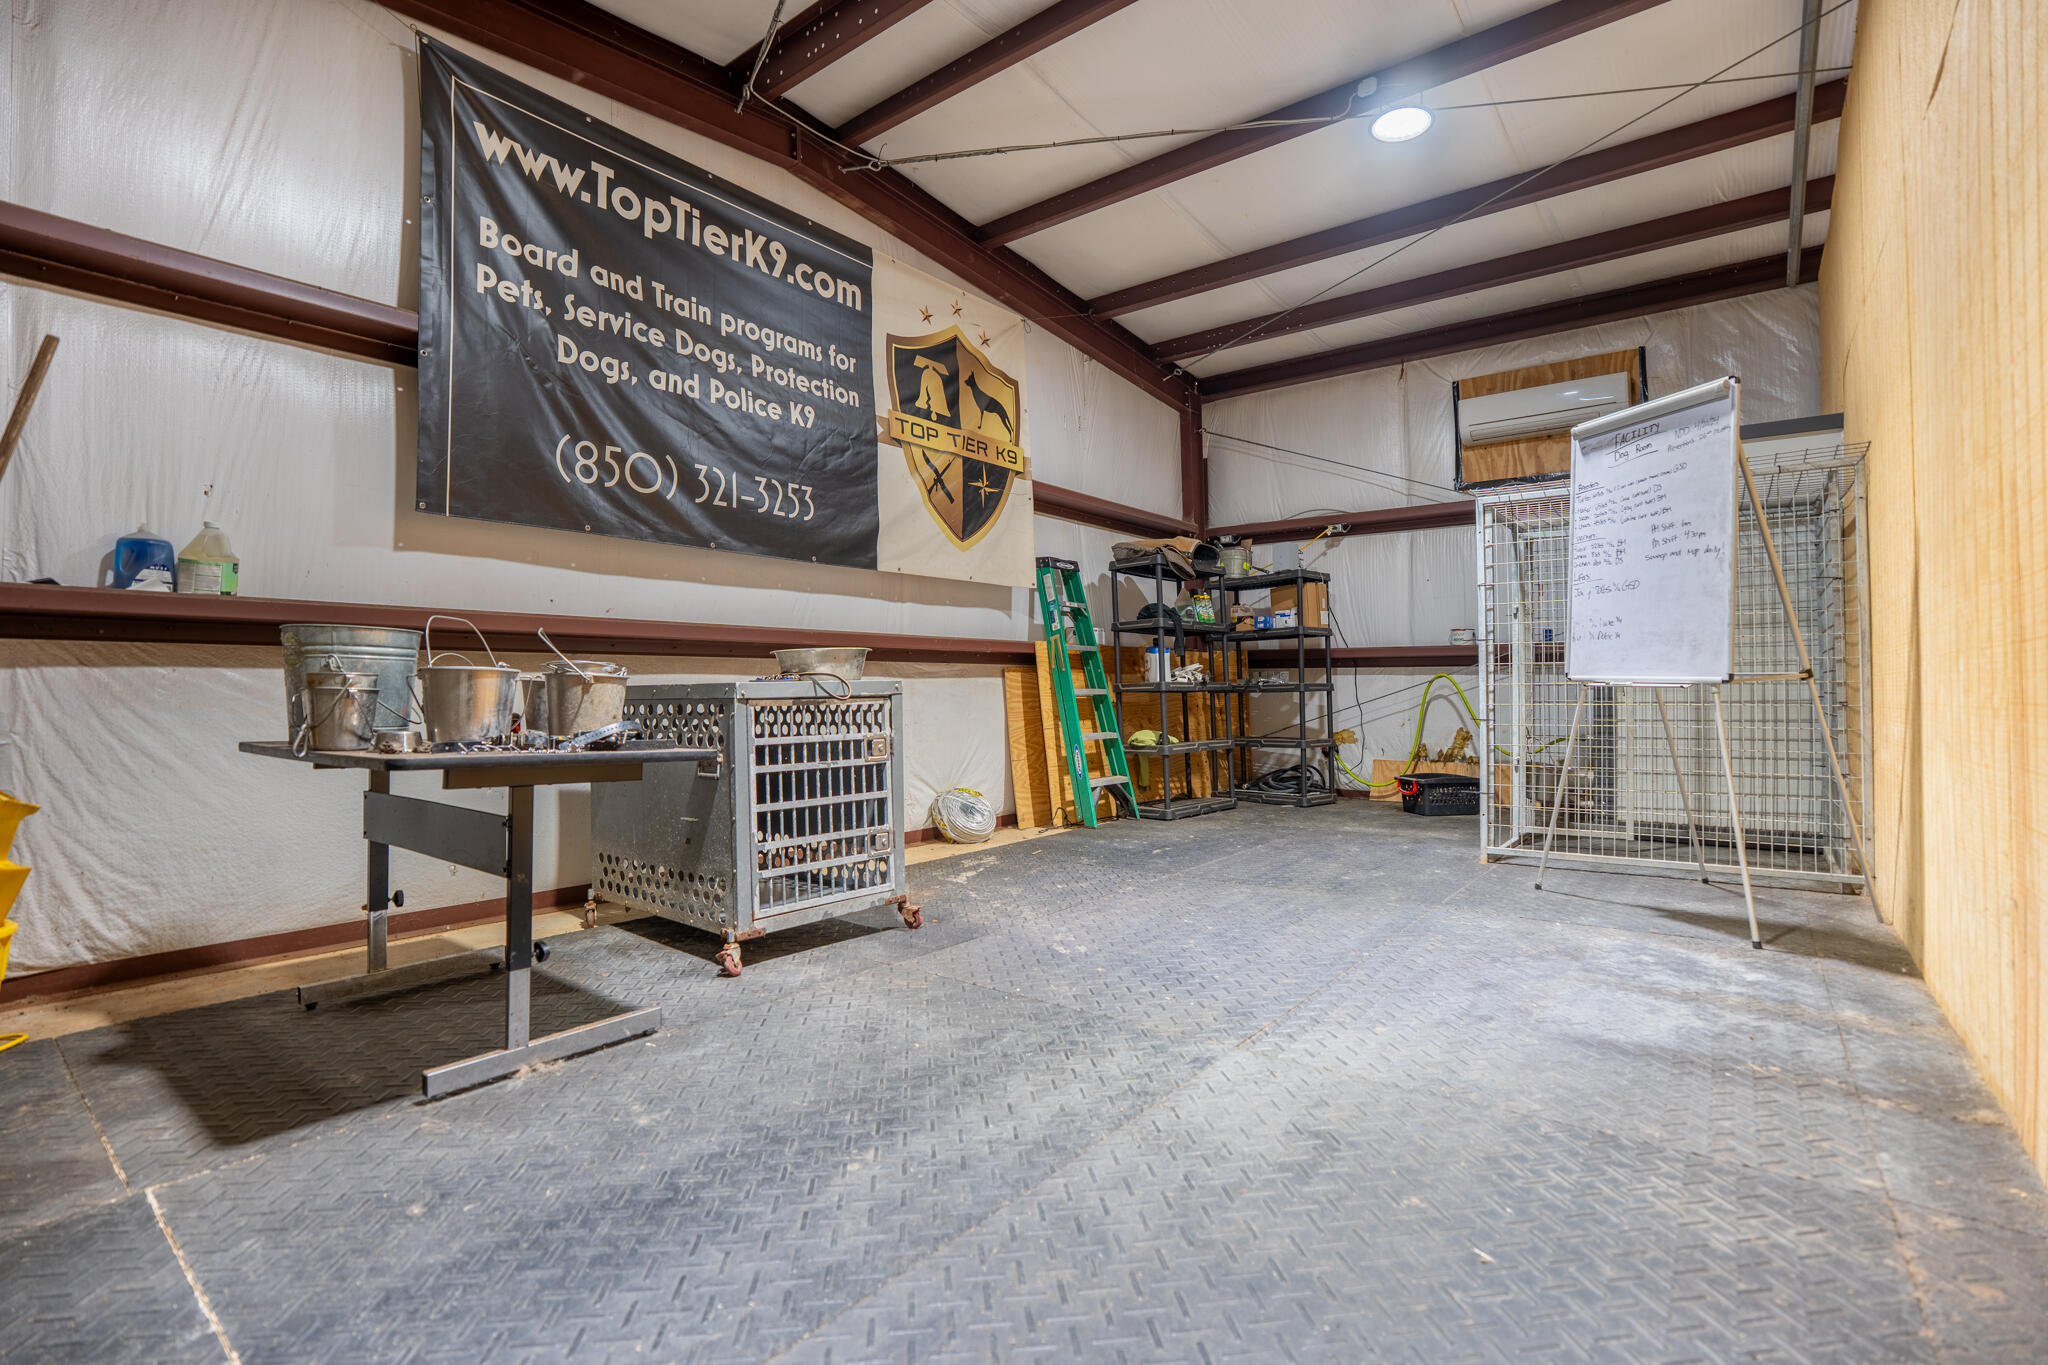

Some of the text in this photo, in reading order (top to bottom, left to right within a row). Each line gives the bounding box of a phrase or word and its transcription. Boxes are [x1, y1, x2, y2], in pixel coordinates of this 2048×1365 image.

[473, 121, 862, 311] www.TopTierK9.com
[476, 263, 859, 408] Pets, Service Dogs, Protection
[479, 216, 856, 373] Board and Train programs for
[557, 334, 816, 429] Dogs, and Police K9
[556, 433, 815, 521] (850) 321-3253
[895, 417, 1018, 465] TOP TIER K9
[1614, 422, 1660, 449] FACILITY
[1614, 443, 1653, 462] Dog Room
